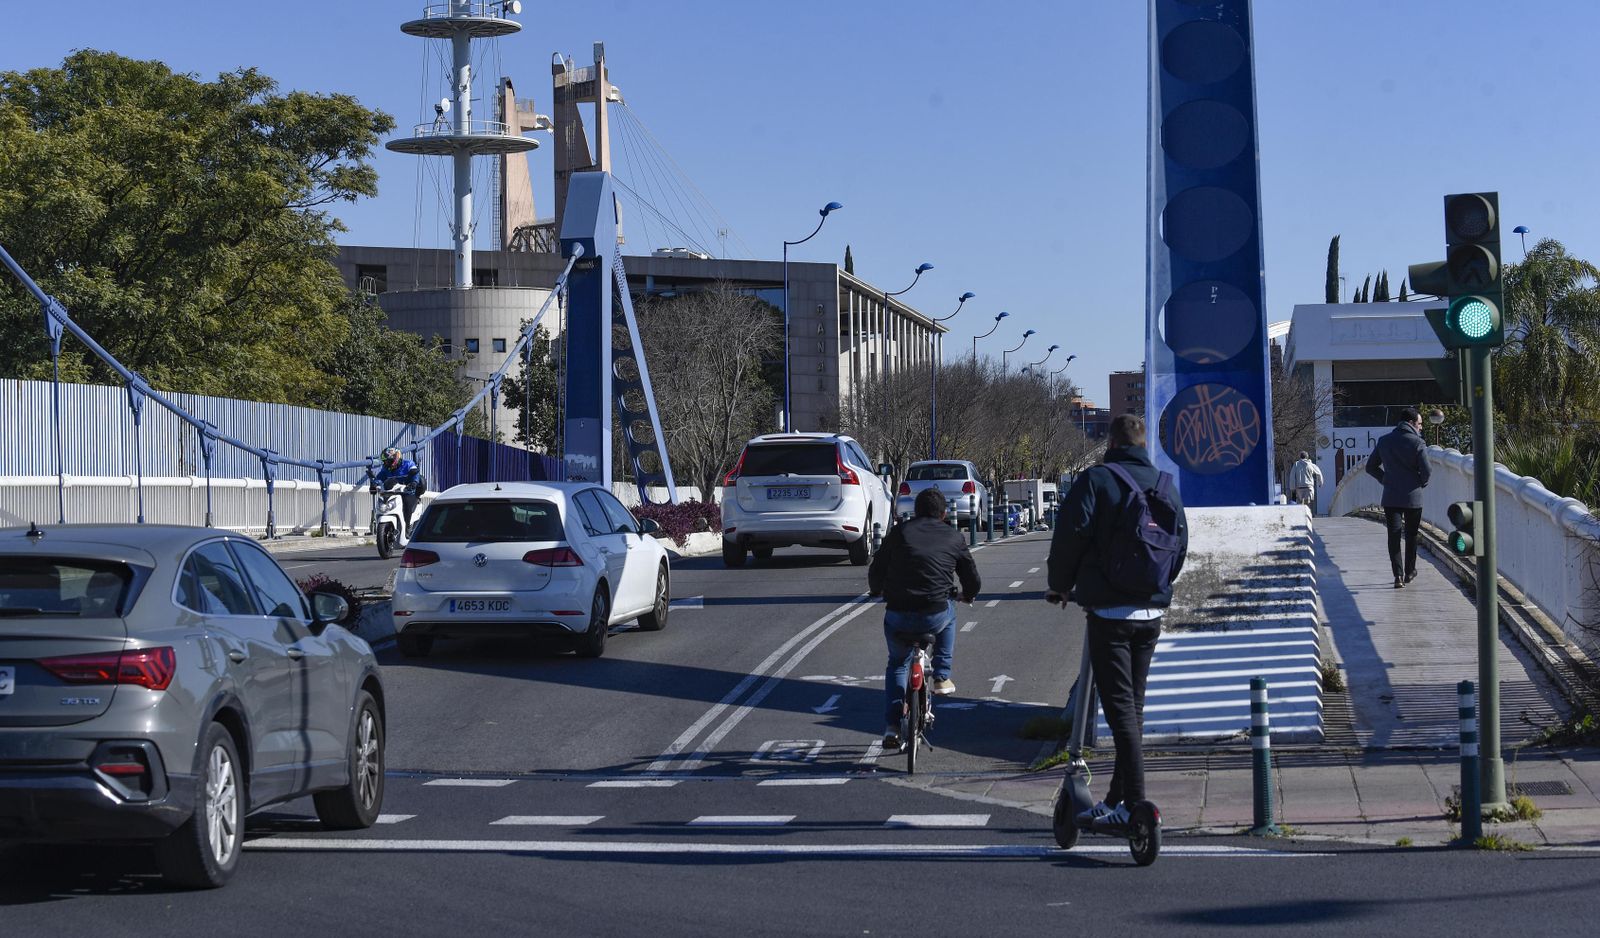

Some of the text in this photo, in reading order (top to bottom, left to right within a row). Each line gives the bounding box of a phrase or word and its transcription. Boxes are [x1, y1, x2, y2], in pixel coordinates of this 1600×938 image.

[772, 488, 809, 497] 2235 JXS
[457, 600, 510, 611] 4653 KDC
